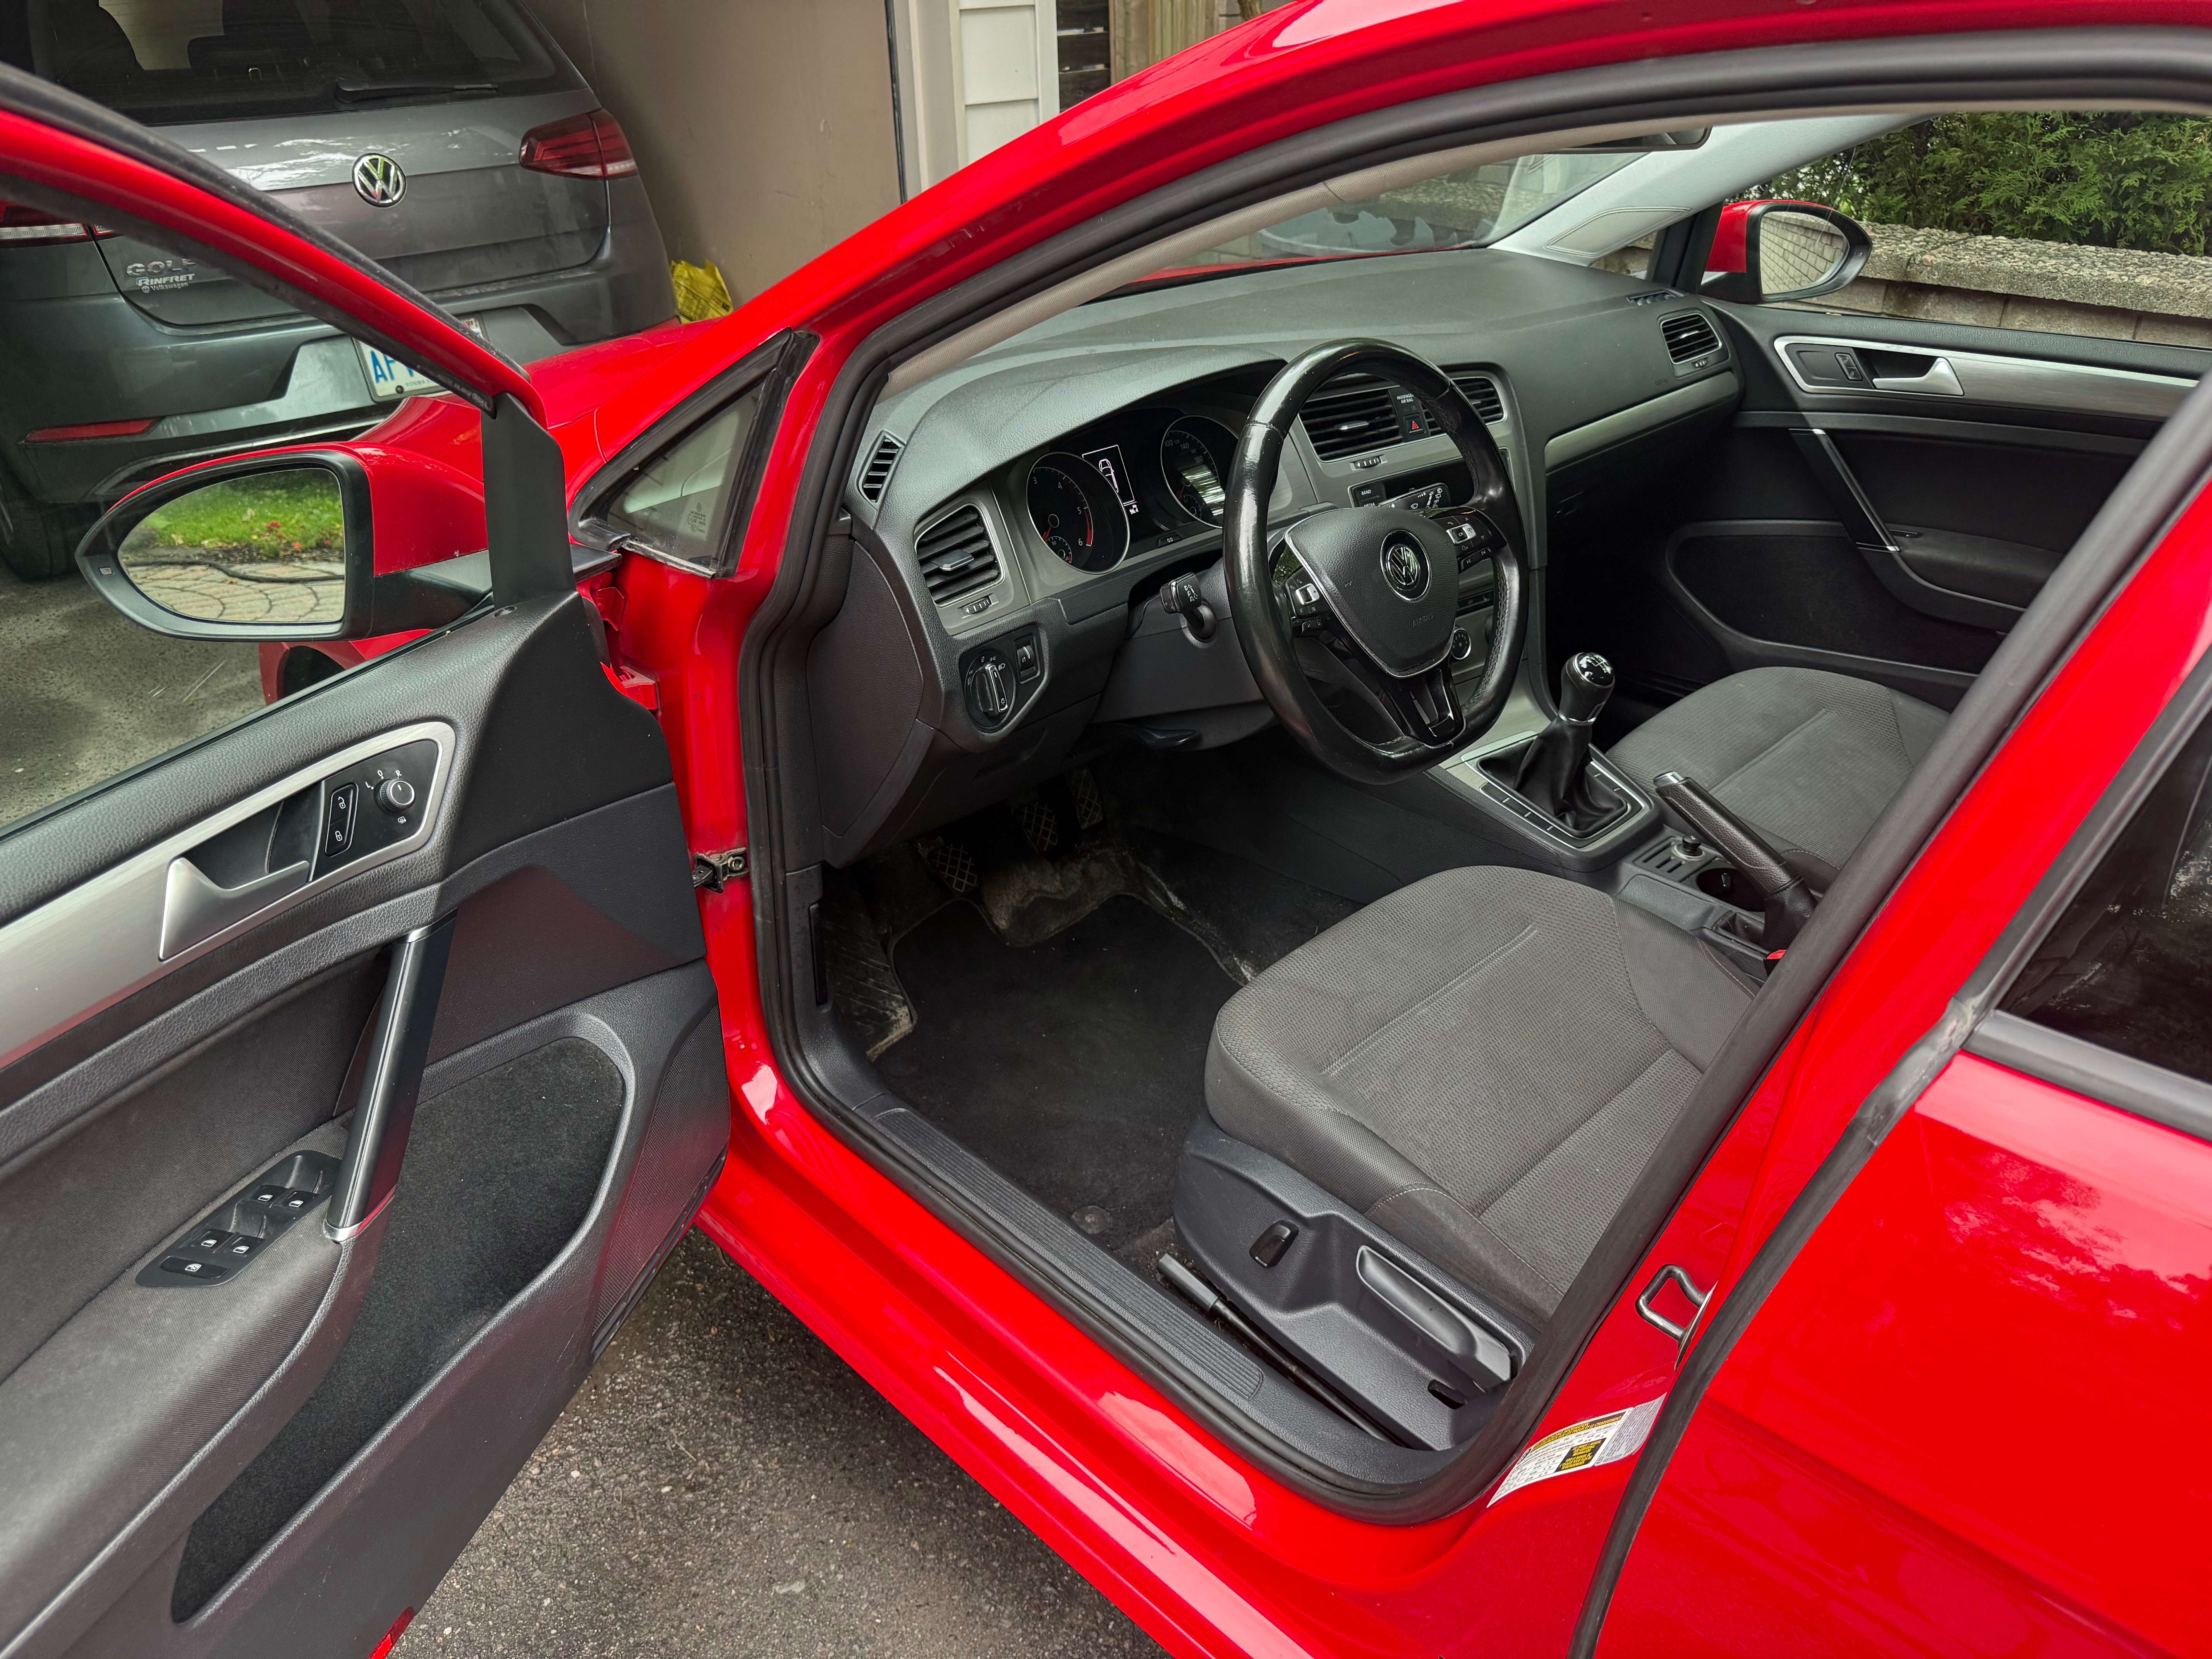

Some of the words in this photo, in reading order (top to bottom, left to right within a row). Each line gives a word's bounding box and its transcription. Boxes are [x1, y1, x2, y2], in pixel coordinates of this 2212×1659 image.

[127, 259, 196, 276] GOLF
[136, 273, 195, 287] RINFRET
[151, 282, 189, 291] Volkswagen
